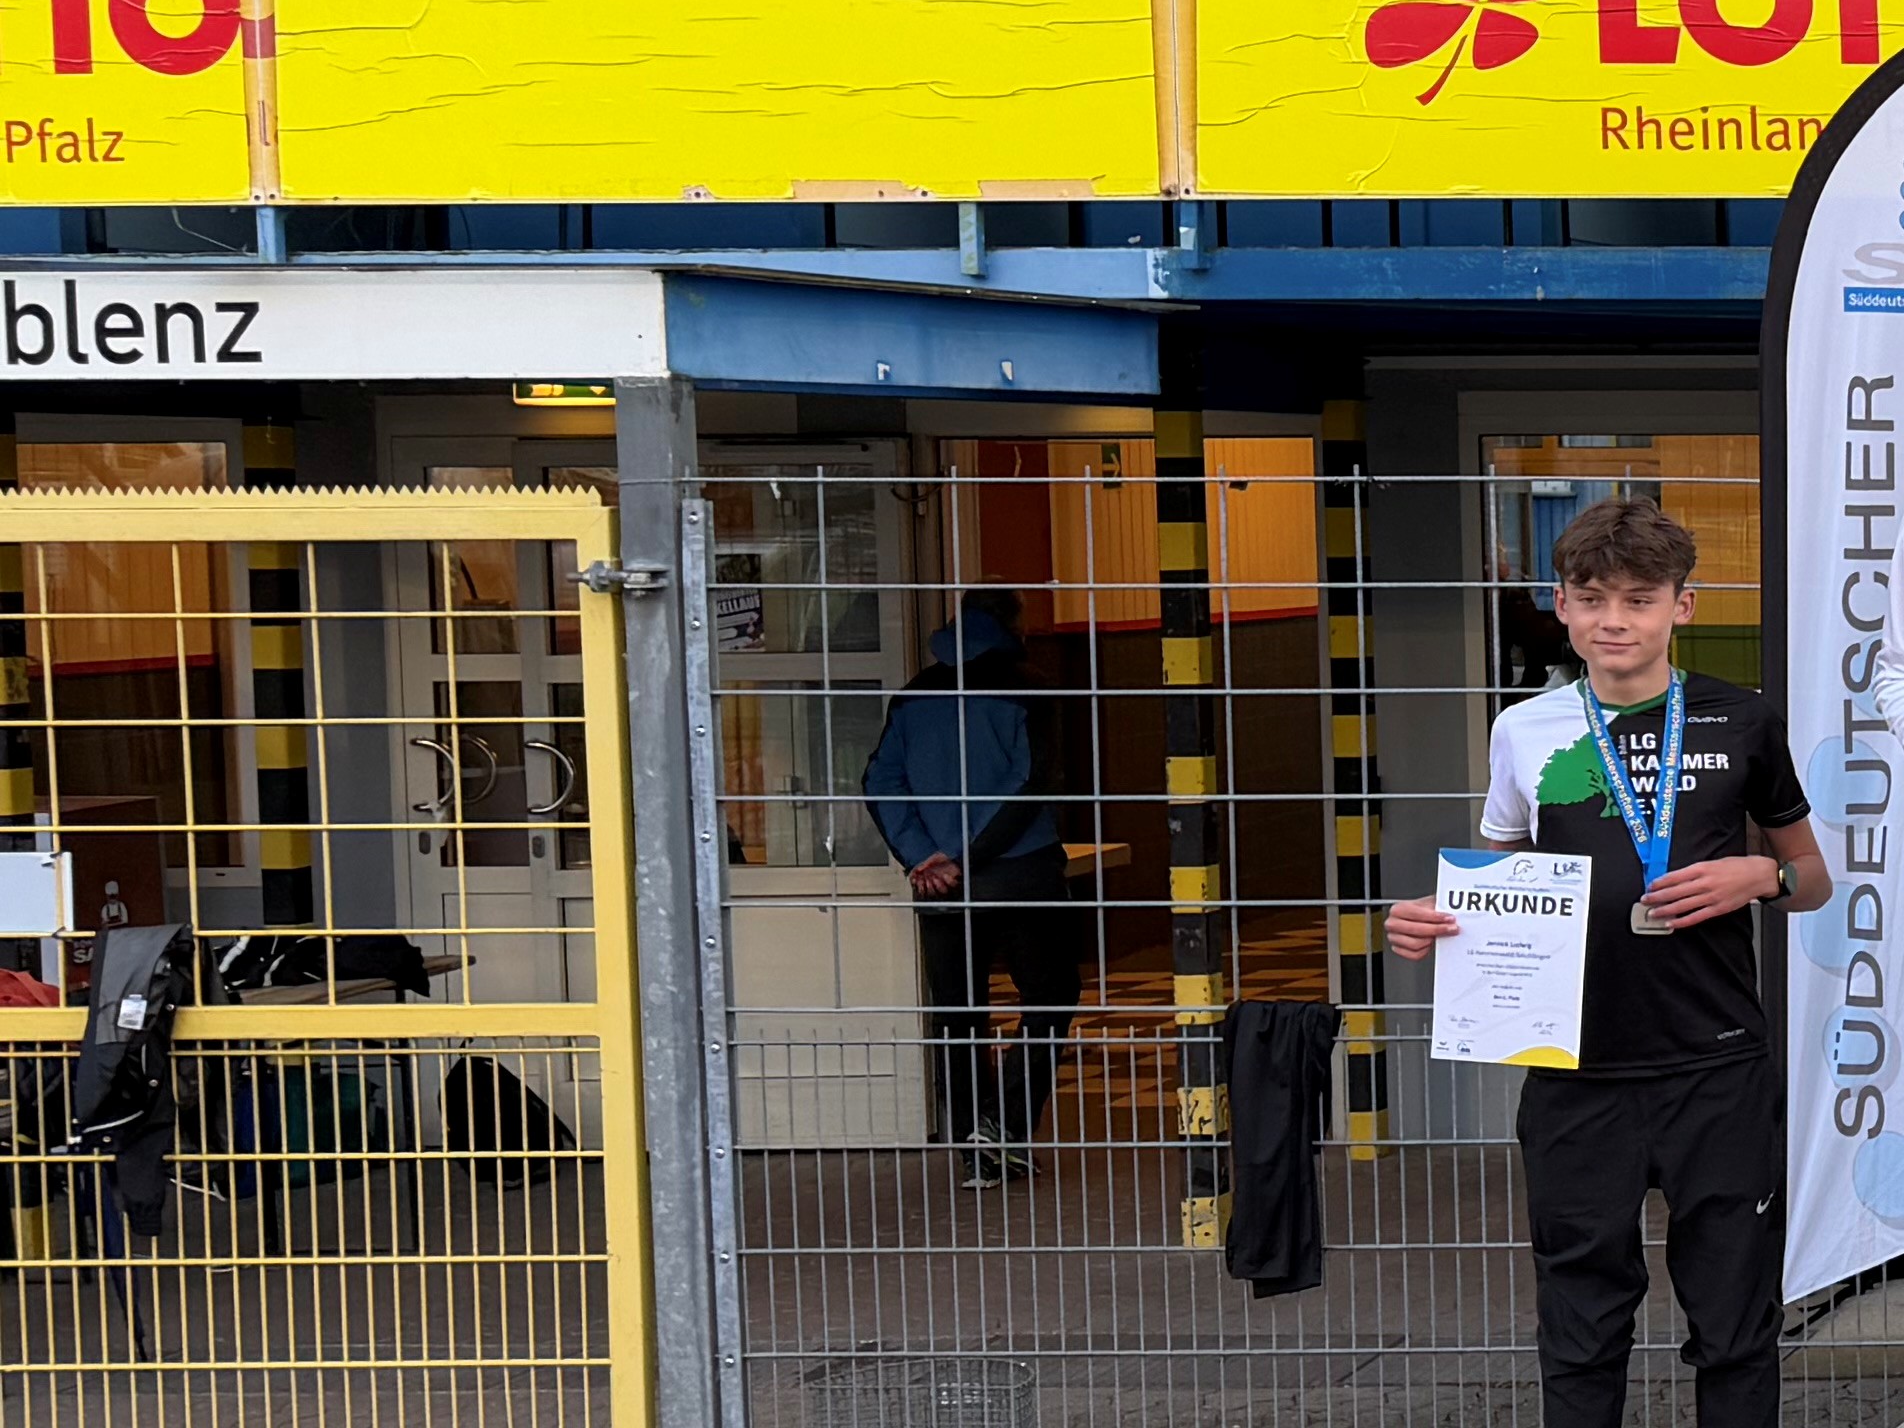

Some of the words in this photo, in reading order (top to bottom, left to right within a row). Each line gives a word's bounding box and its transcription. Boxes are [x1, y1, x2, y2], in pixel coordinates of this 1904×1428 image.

[4, 119, 125, 163] Pfalz
[1601, 106, 1824, 151] Rheinlan
[3, 279, 263, 365] blenz
[1630, 733, 1657, 751] LG
[1630, 753, 1730, 772] KAMER
[1832, 373, 1895, 1141] SÜDDEUTSCHER
[1448, 889, 1575, 917] URKUNDE
